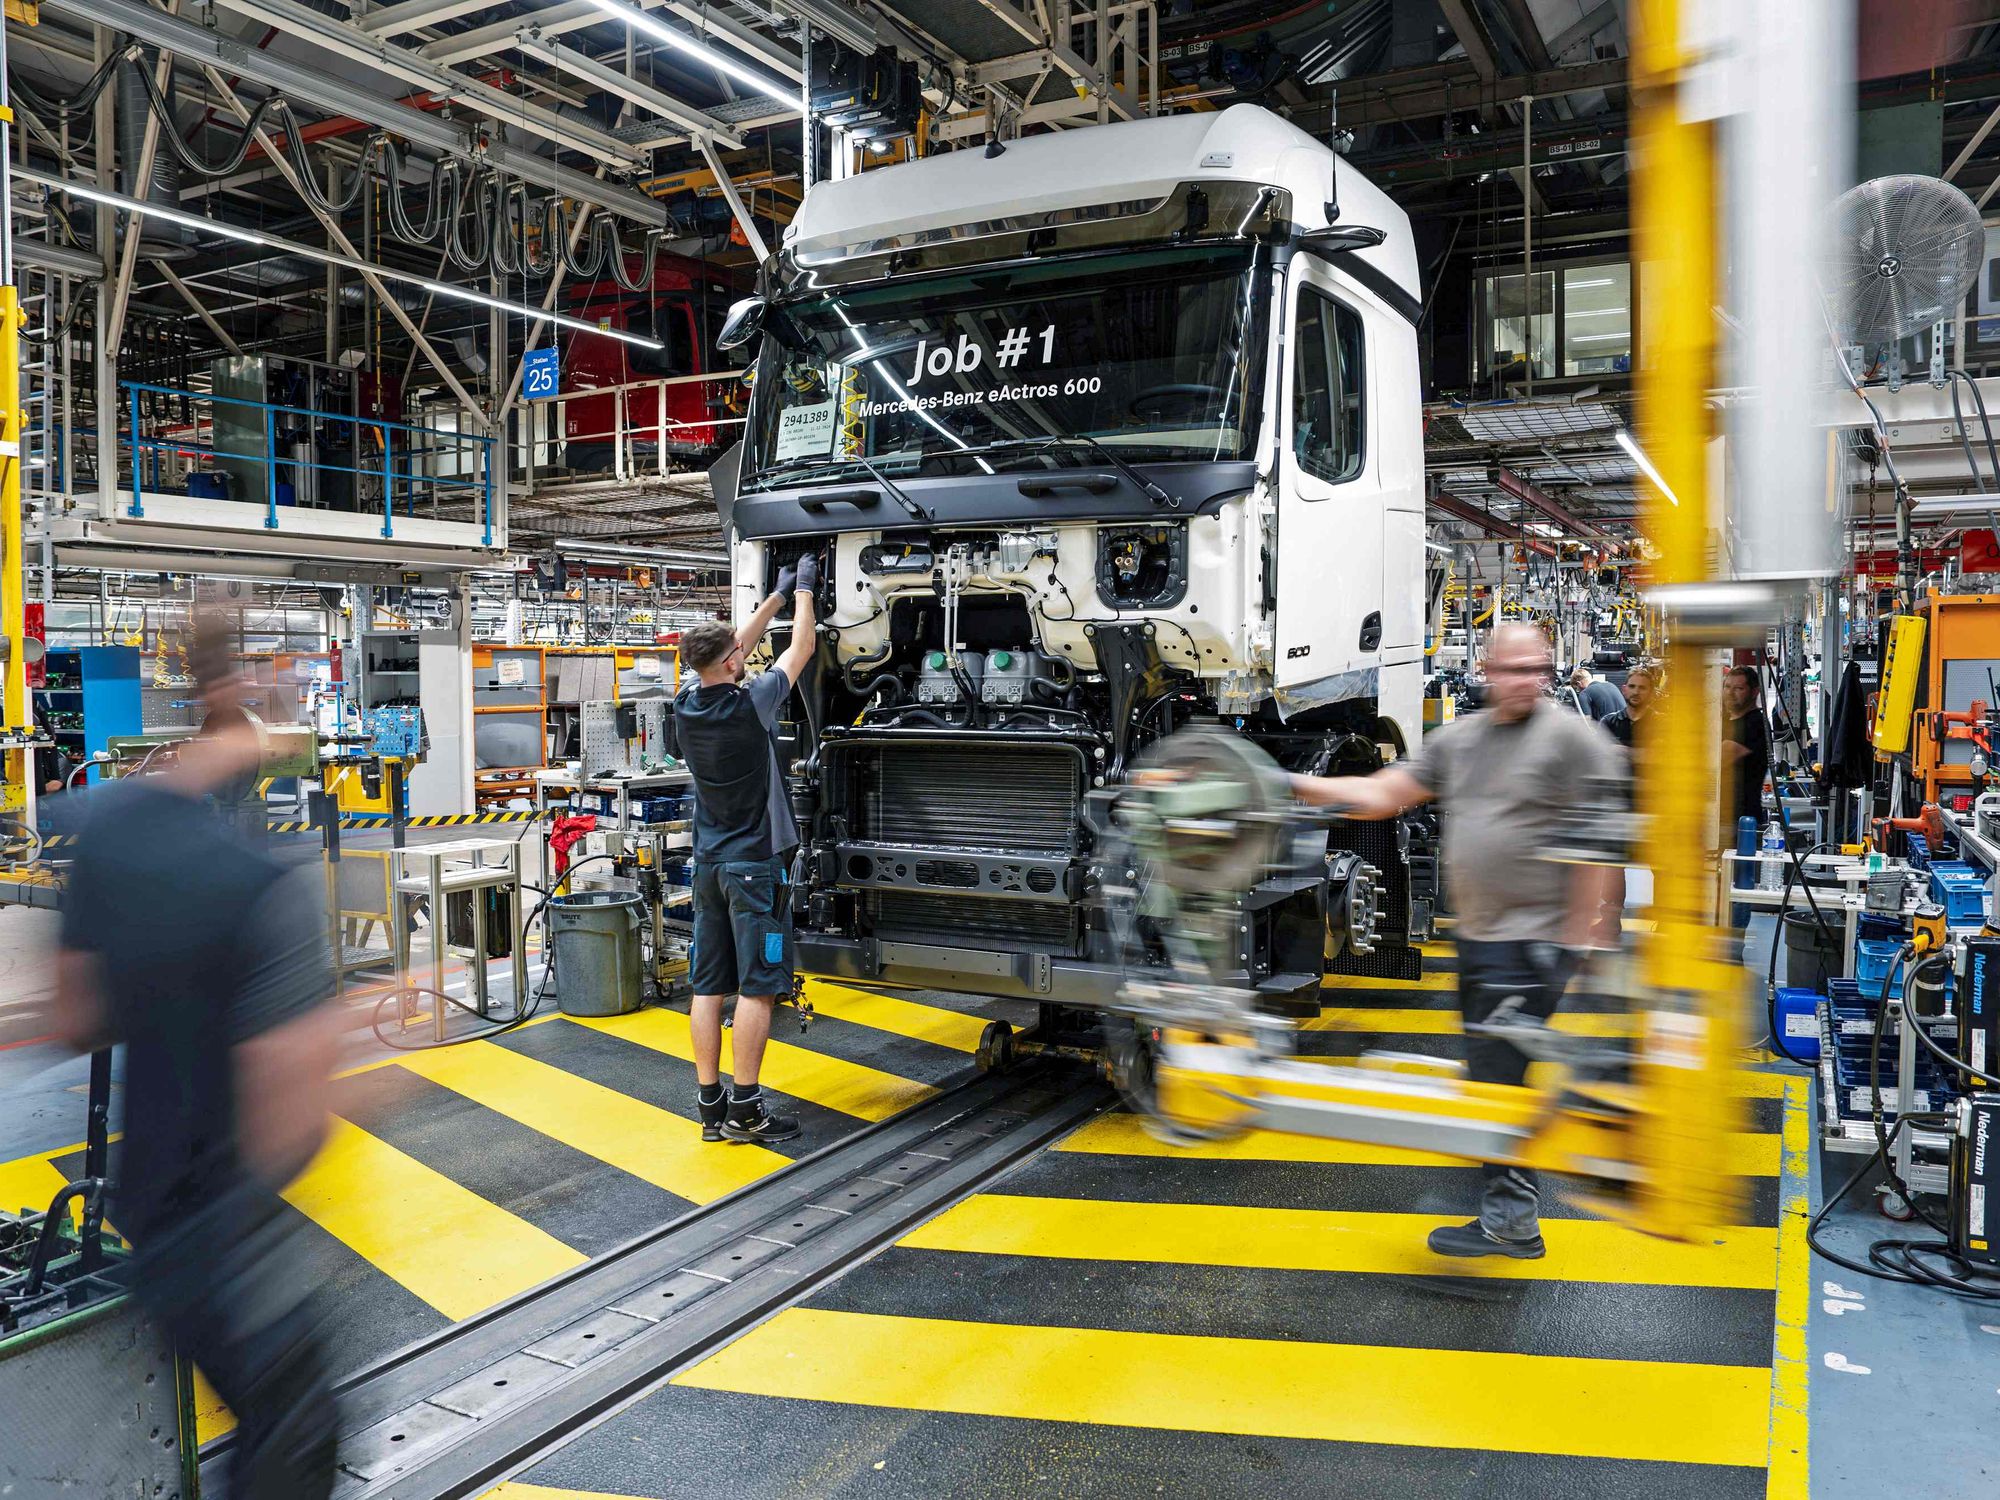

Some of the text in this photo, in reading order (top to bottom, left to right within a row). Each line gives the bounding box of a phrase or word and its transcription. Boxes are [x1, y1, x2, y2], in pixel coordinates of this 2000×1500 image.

[1550, 144, 1571, 153] BS-01
[1576, 140, 1599, 149] BS-02
[906, 324, 1056, 387] Job #1
[529, 367, 553, 392] 25
[859, 376, 1101, 418] Mercedes-Benz eActros 600
[783, 410, 829, 427] 2941389
[1287, 644, 1311, 659] 600
[1973, 952, 1986, 1015] Nederman
[1974, 1110, 1991, 1176] Nederman
